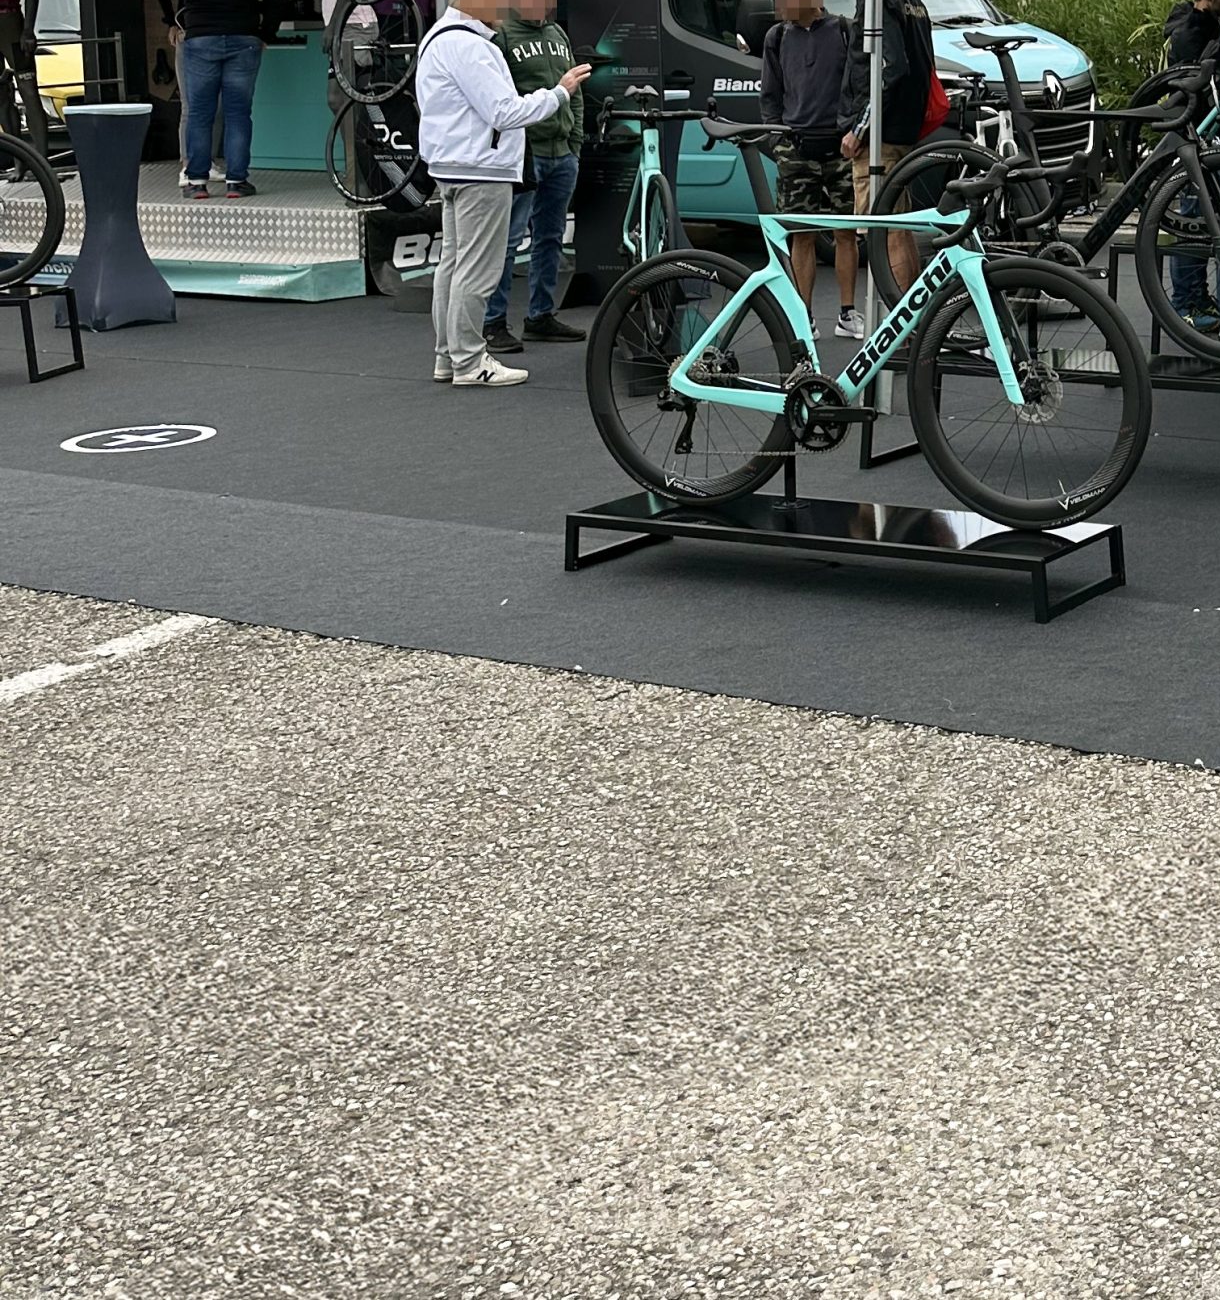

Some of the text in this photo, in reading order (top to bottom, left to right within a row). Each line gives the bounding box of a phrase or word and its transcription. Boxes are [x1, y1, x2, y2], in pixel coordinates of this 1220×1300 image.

[512, 41, 544, 62] PLAY
[713, 78, 761, 92] Bianc
[845, 252, 954, 389] Bianchi
